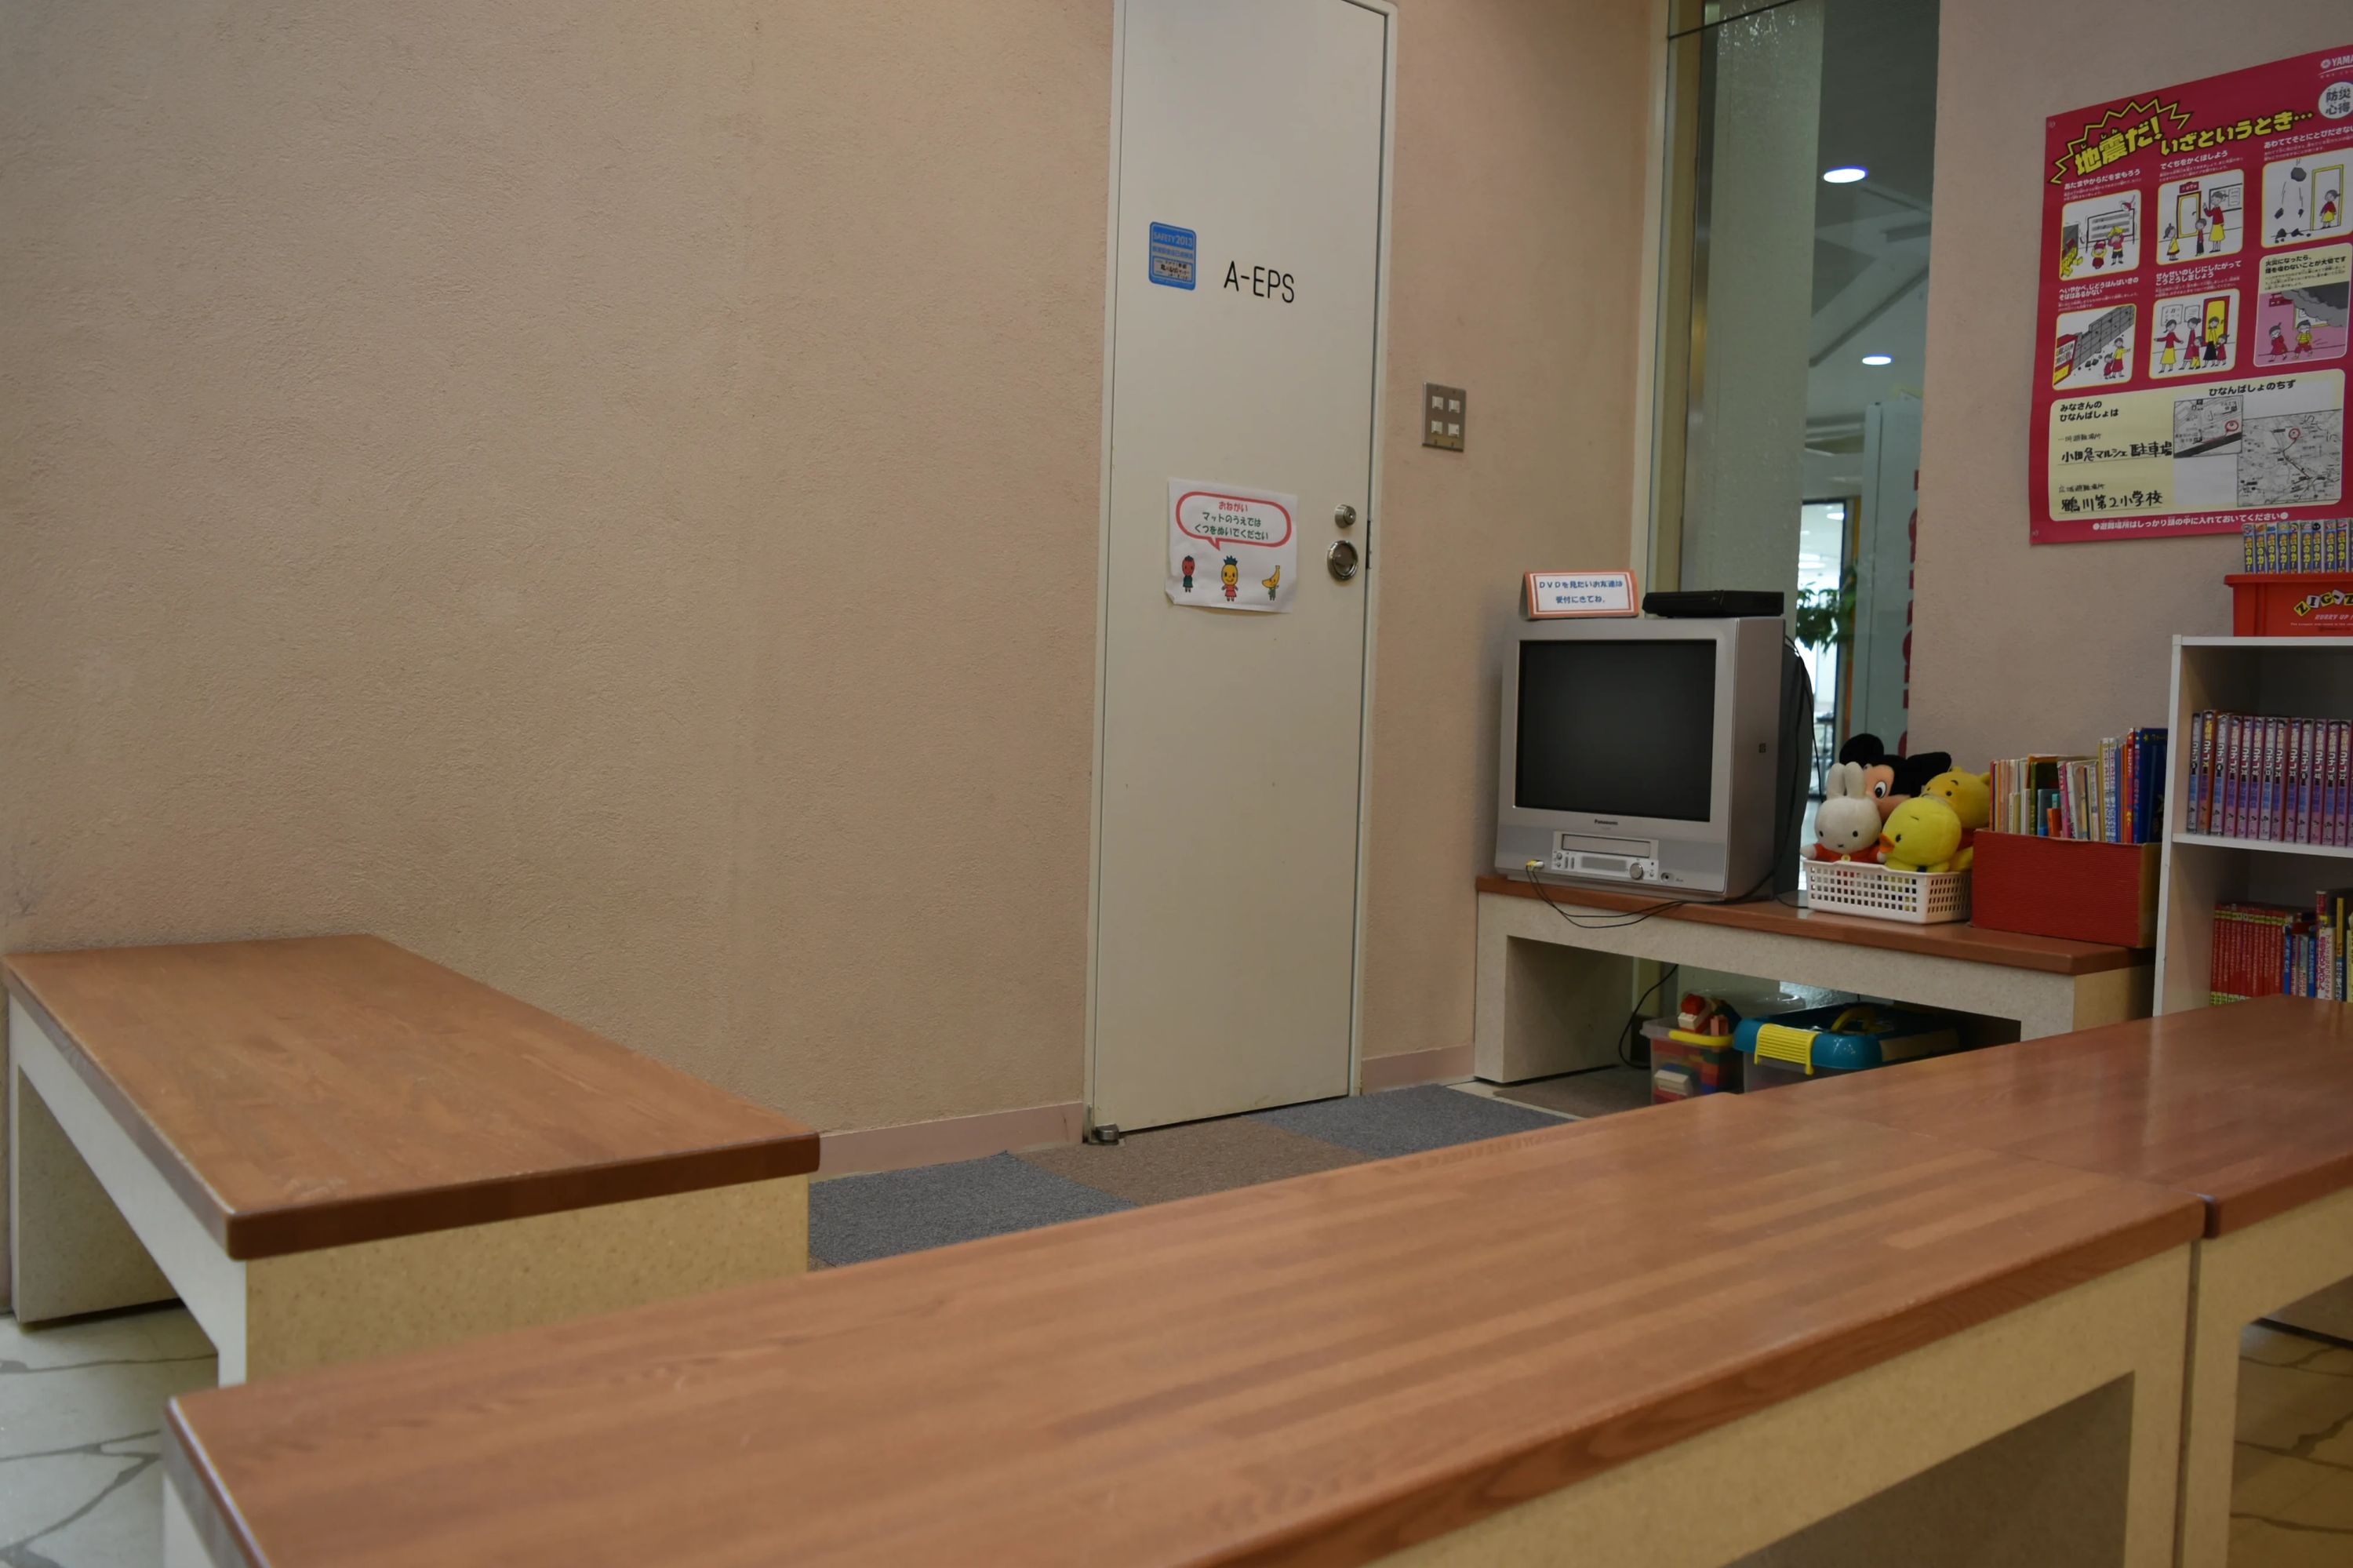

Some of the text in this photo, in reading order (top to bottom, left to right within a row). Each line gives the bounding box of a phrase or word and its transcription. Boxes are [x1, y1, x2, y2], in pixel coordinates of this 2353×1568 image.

[2326, 89, 2351, 103] 防災
[2326, 102, 2351, 115] 心得
[1224, 260, 1294, 304] A-EPS
[2208, 379, 2297, 396] ひなんばしょのちず
[2060, 401, 2102, 413] みなさんの
[2060, 409, 2119, 422] ひなんばしょは
[1218, 501, 1249, 512] おねがい
[1202, 511, 1261, 527] マットのうえでは
[1195, 524, 1268, 540] くつをぬいでください
